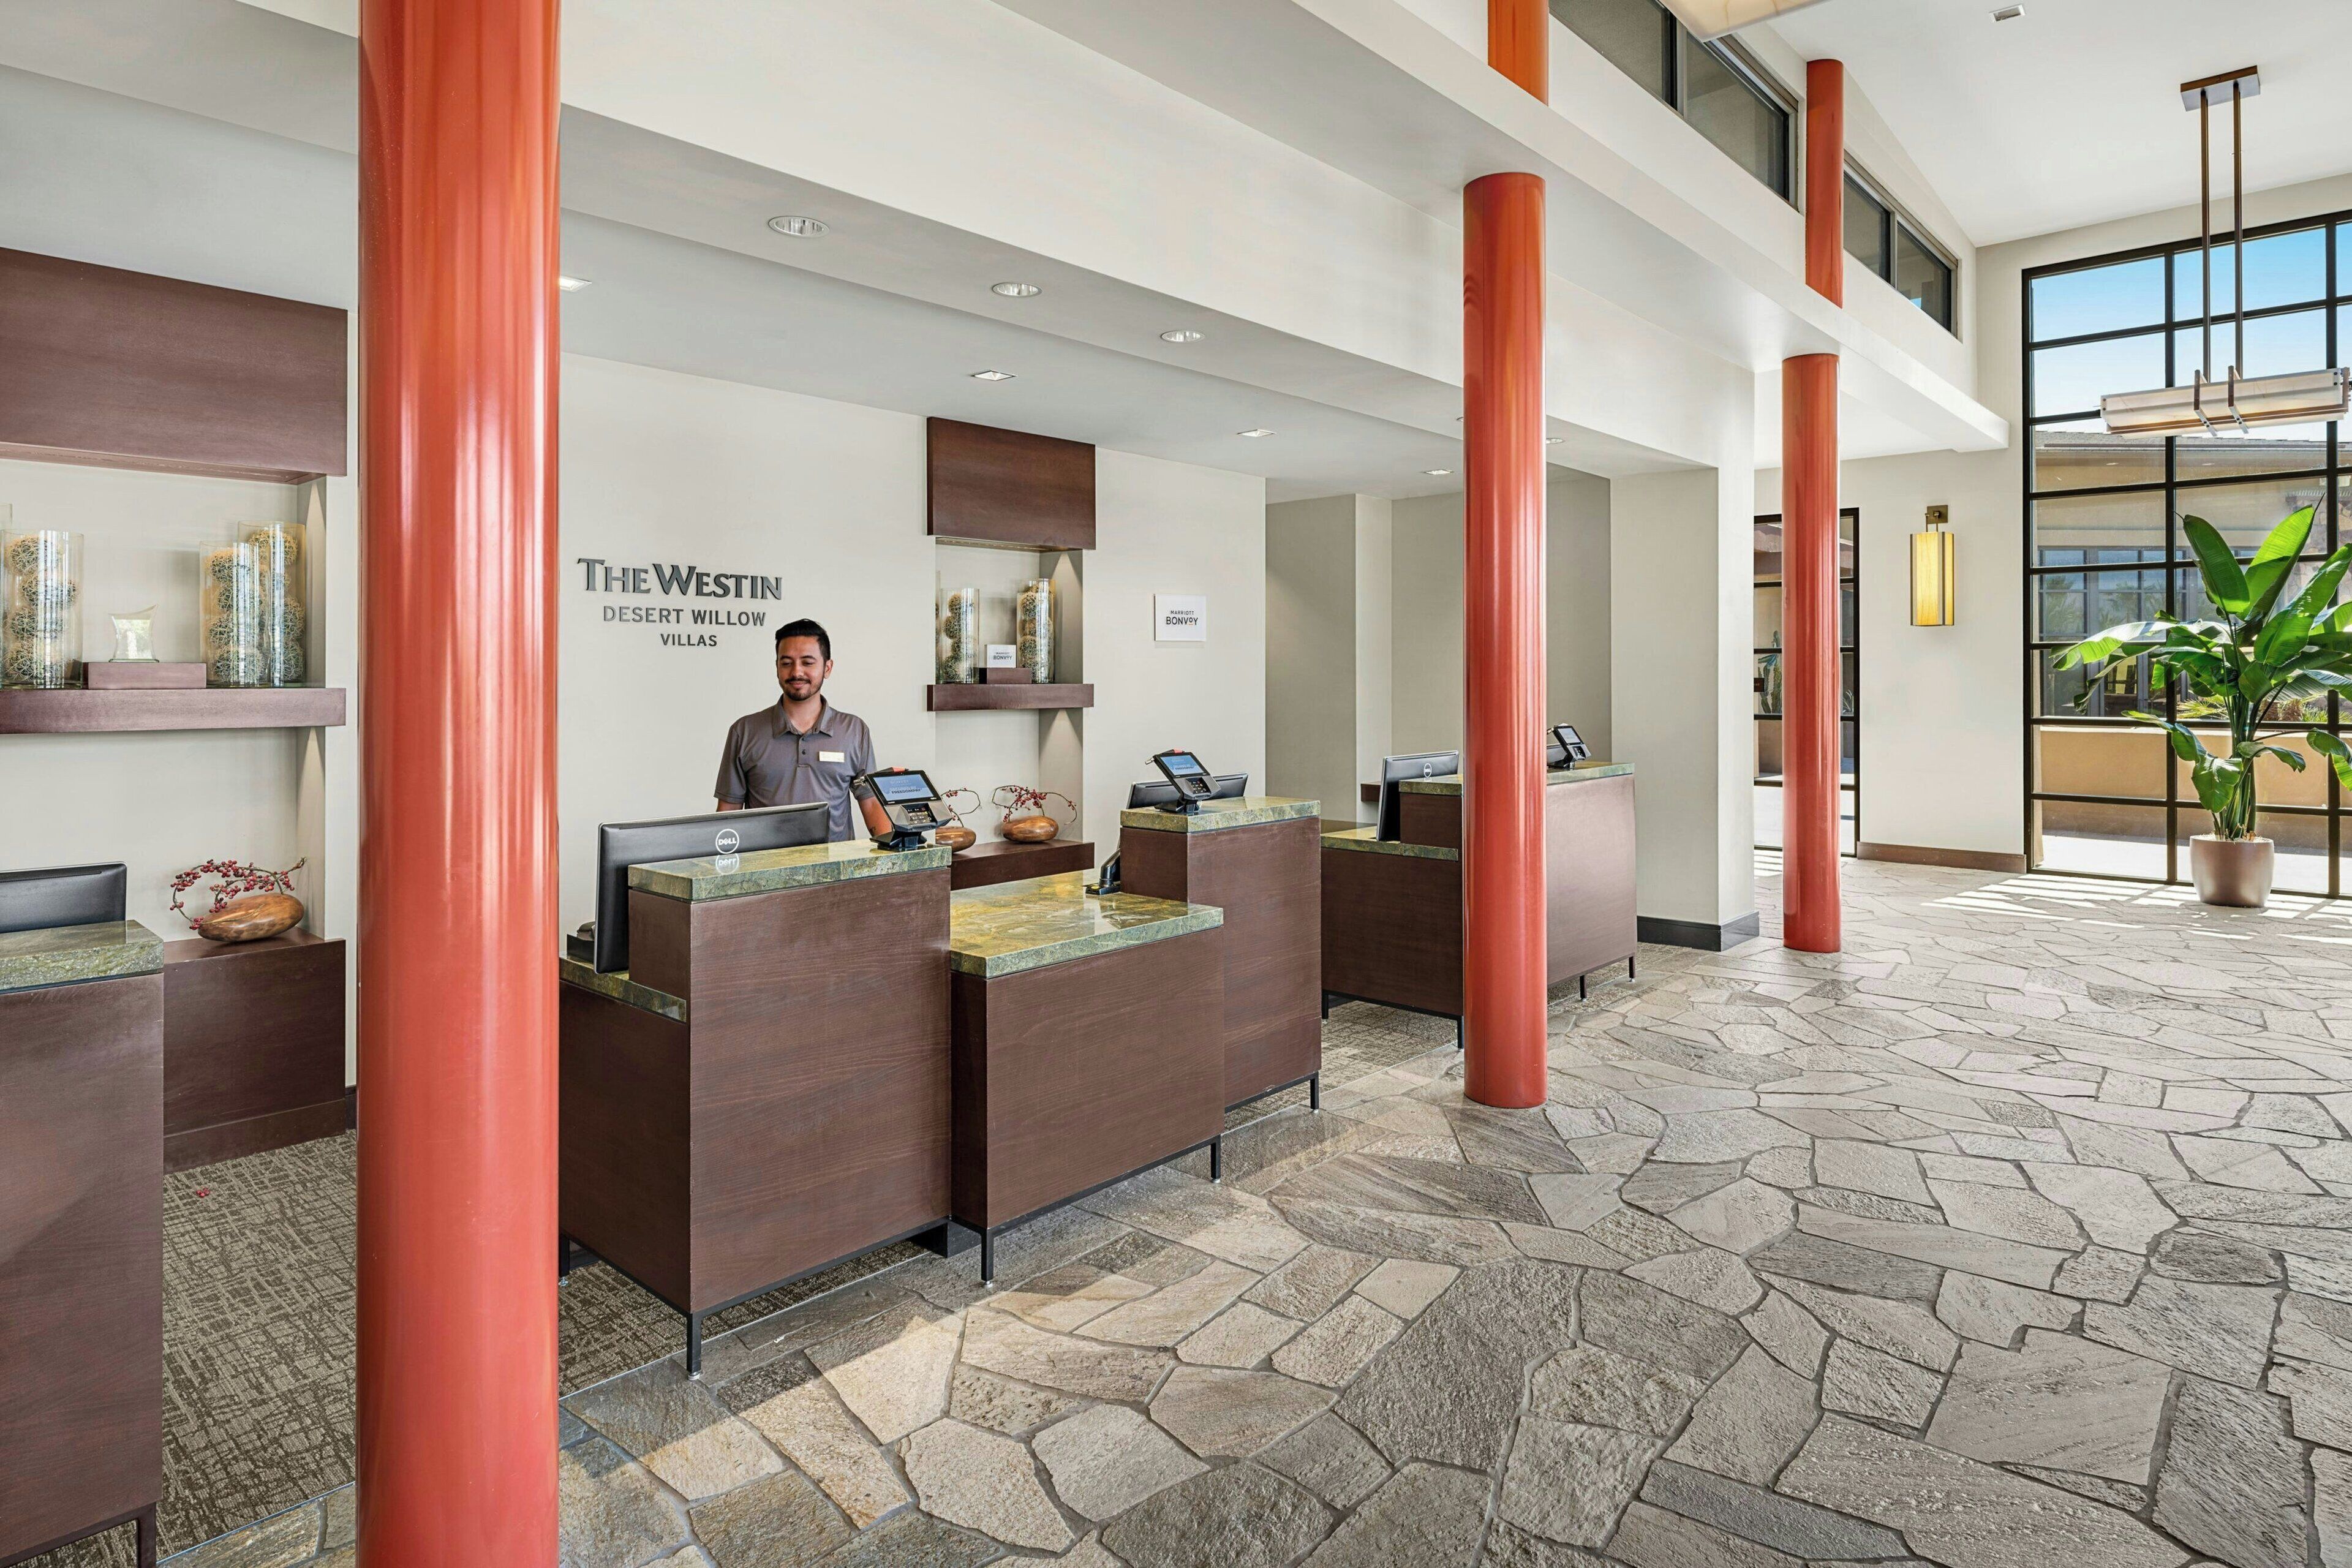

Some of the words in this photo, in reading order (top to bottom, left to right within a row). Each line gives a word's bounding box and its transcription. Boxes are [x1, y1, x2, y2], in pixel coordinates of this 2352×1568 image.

[577, 558, 651, 594] THE
[652, 563, 783, 600] WESTIN
[603, 606, 684, 624] DESERT
[692, 609, 766, 626] WILLOW
[660, 633, 717, 647] VILLAS
[718, 837, 737, 846] DELL
